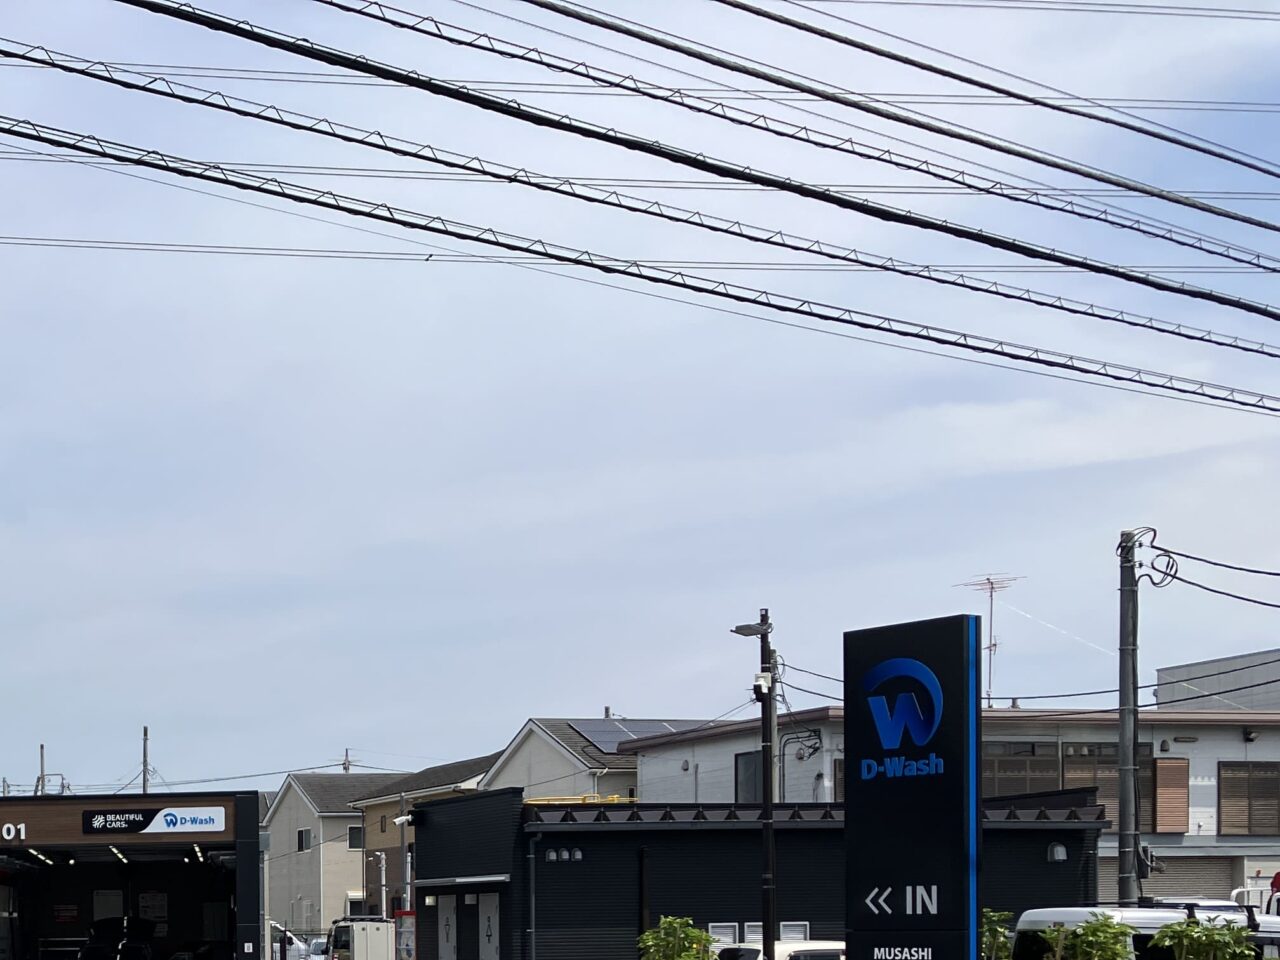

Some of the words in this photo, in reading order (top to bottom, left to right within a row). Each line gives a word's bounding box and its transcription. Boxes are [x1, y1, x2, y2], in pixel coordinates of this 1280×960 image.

[861, 753, 944, 780] D-Wash
[106, 813, 144, 821] BEAUTIFUL
[180, 816, 215, 826] D-Wash
[1, 823, 26, 840] 01
[906, 885, 938, 915] IN
[873, 947, 933, 960] MUSASHI
